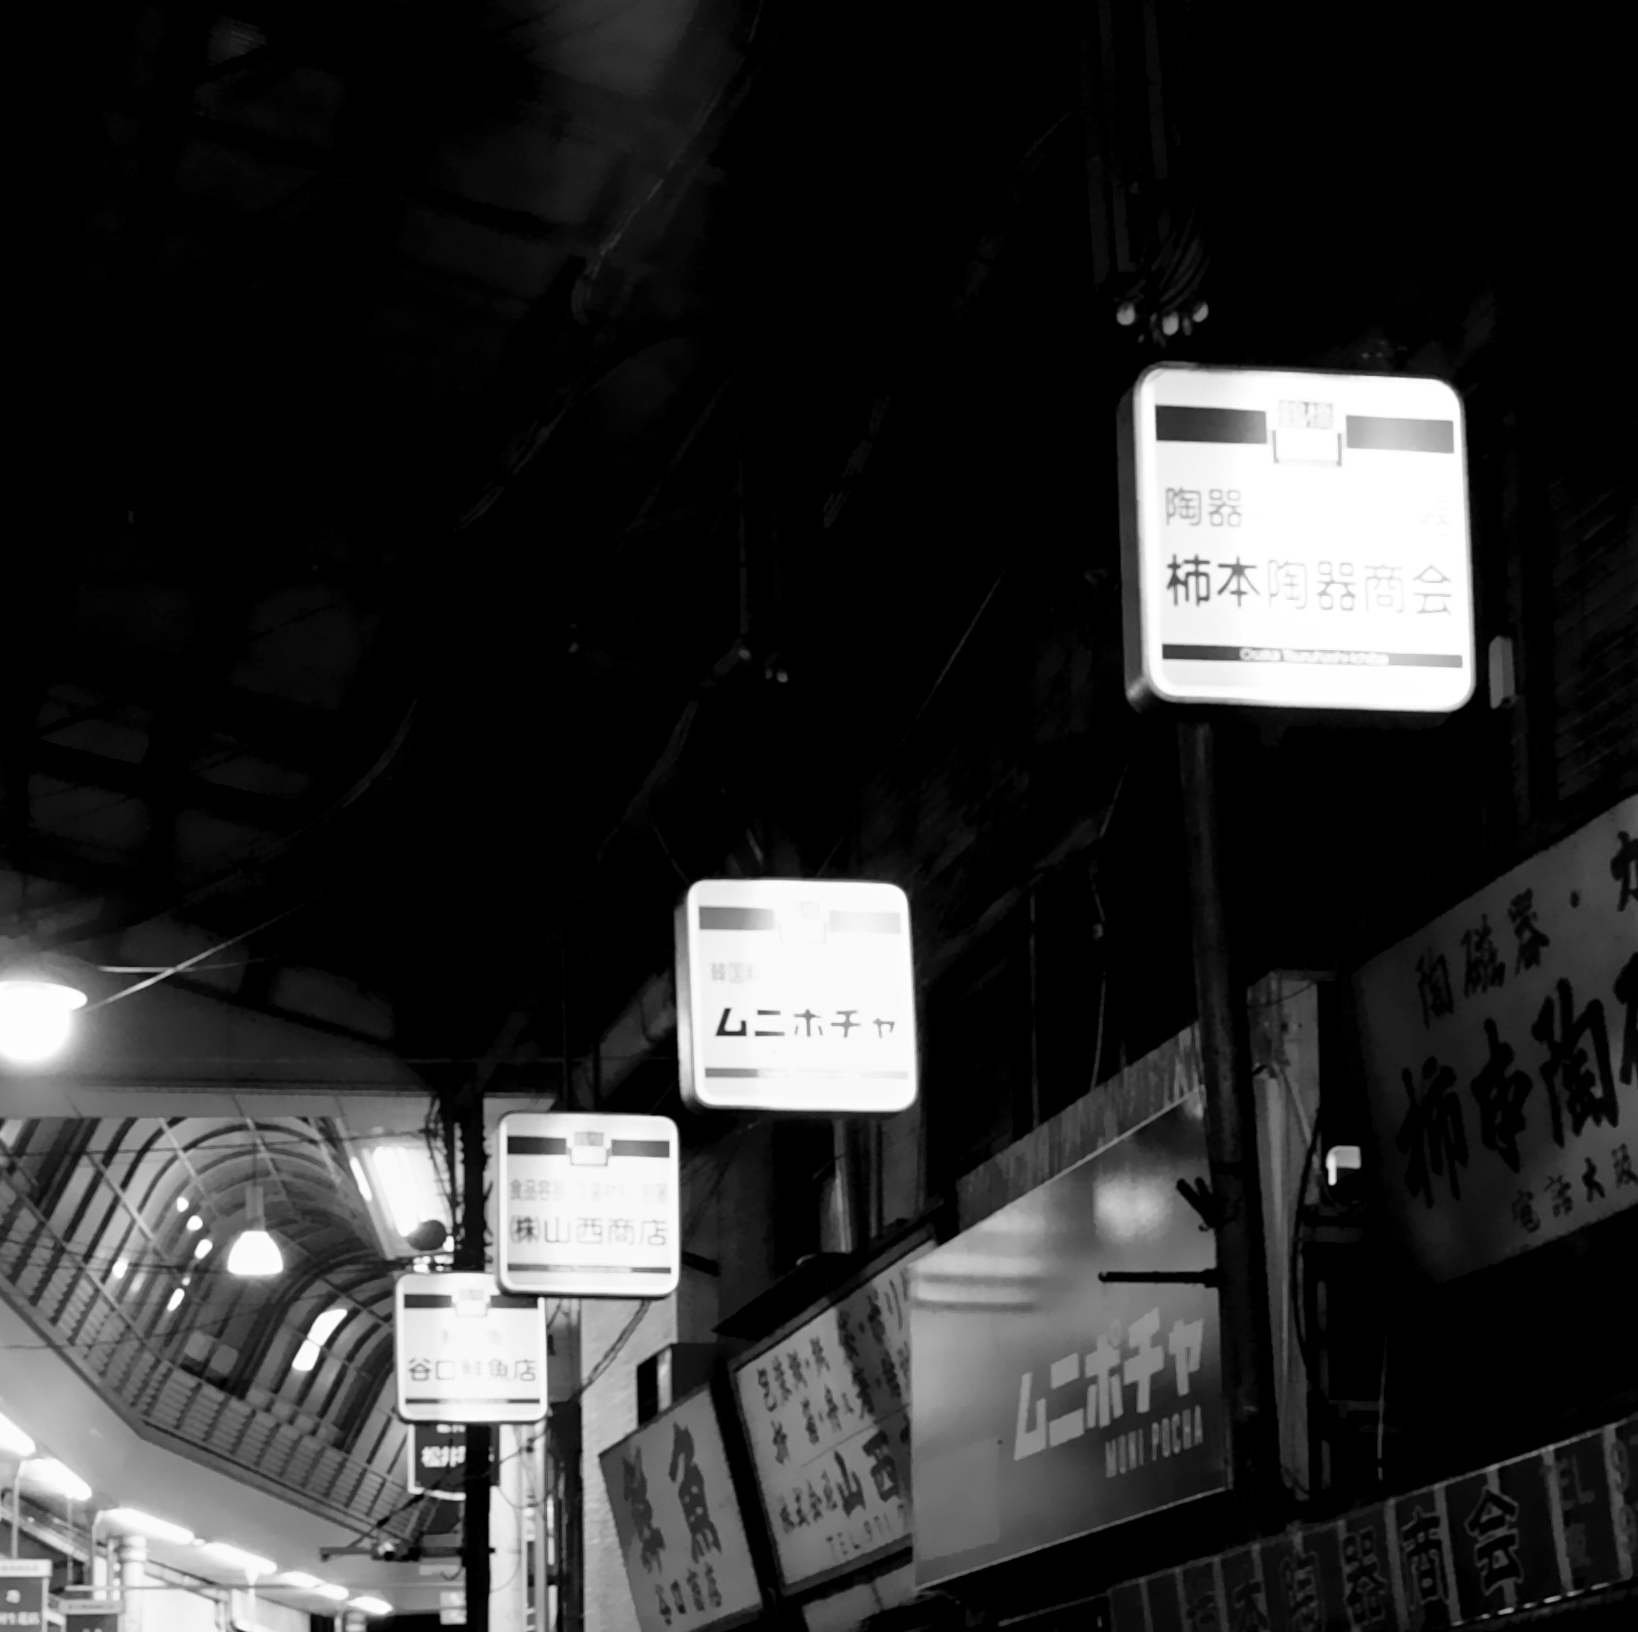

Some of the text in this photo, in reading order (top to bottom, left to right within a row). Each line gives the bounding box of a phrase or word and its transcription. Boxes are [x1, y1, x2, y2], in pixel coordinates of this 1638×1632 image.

[1166, 552, 1453, 616] 柿本陶器商会
